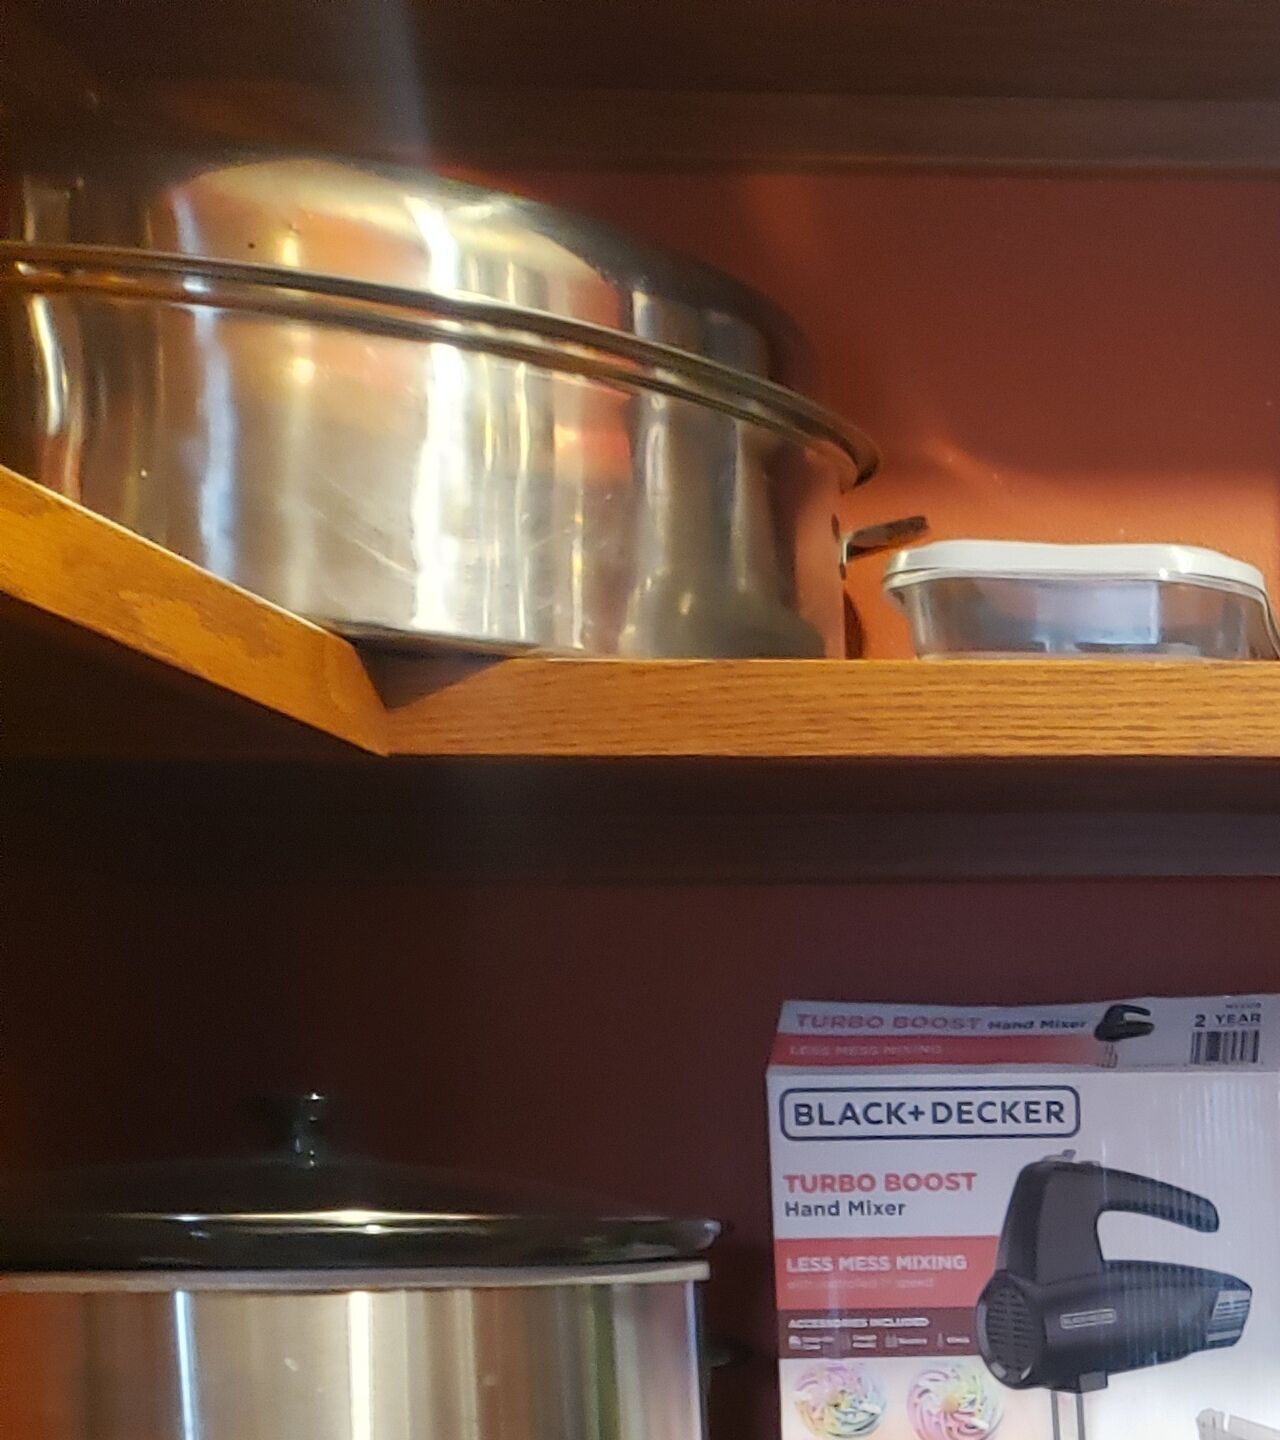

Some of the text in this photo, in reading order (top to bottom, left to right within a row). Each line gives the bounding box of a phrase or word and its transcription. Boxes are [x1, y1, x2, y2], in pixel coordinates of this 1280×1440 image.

[796, 1013, 884, 1030] TURBO
[892, 1015, 982, 1031] BOOST
[1040, 1019, 1087, 1031] Mixer
[1194, 1012, 1262, 1028] 2 YEAR
[784, 1171, 977, 1193] TURBO BOOST
[785, 1199, 906, 1218] Hand Mixer
[786, 1254, 967, 1273] LESS MESS MIXING
